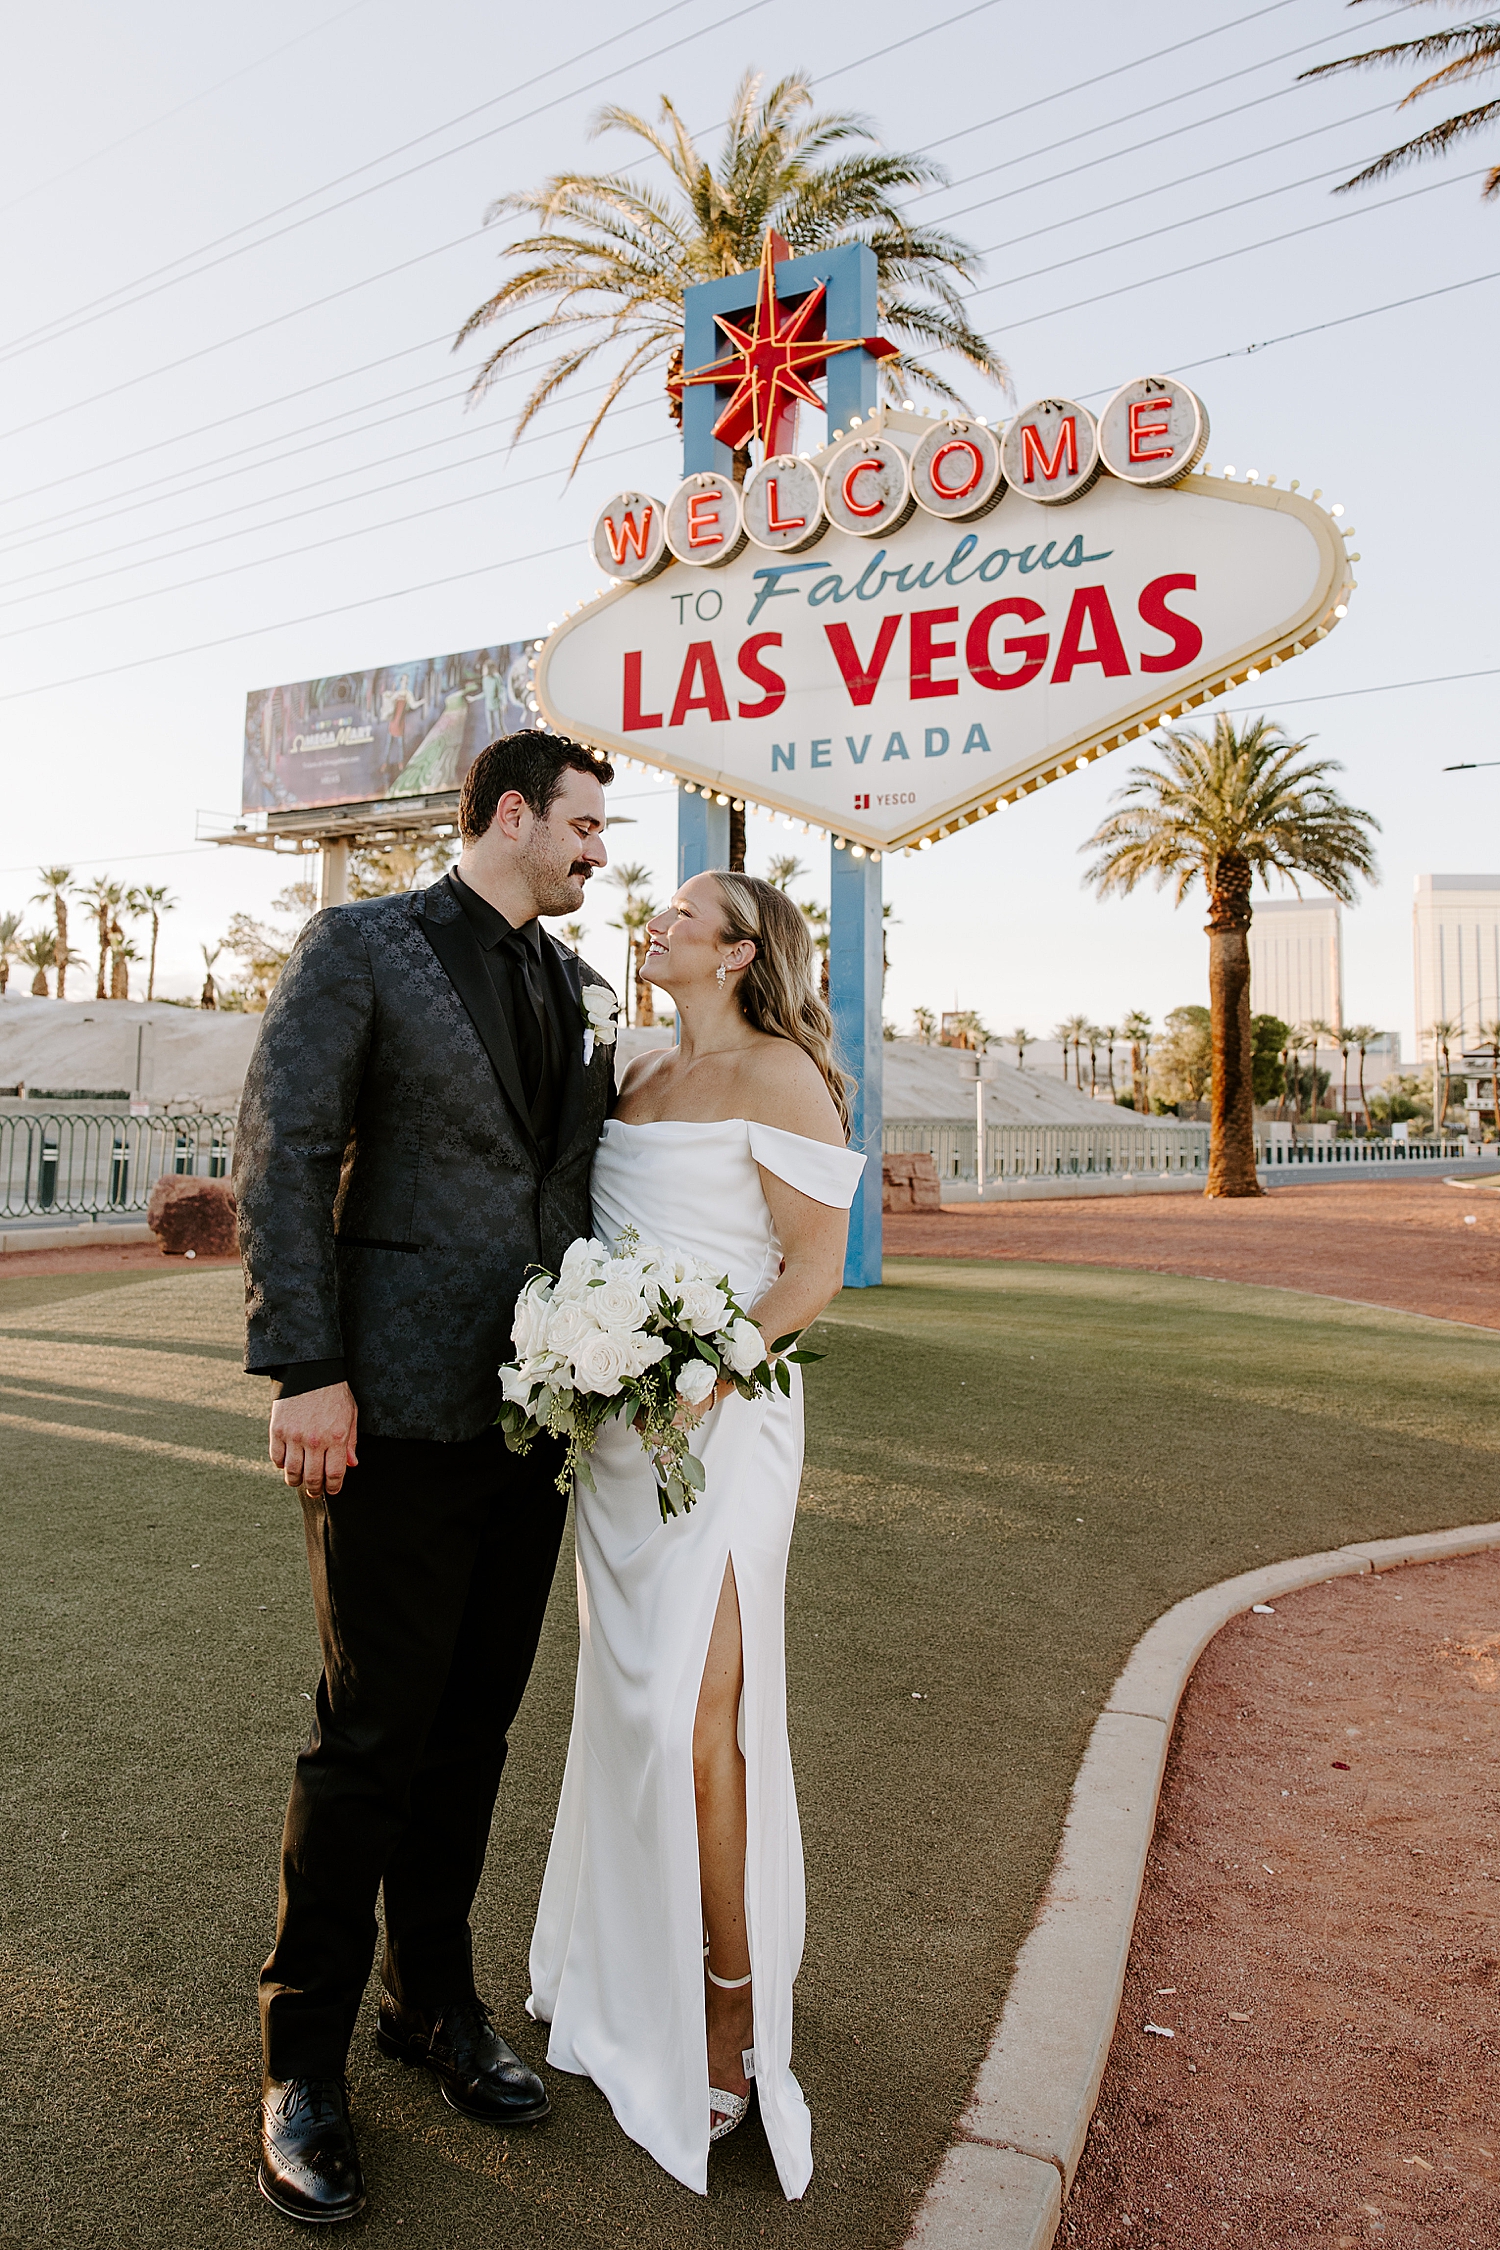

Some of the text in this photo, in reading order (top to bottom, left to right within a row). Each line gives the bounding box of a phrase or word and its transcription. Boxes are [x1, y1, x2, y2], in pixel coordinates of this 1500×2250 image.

[603, 397, 1174, 566] WELCOME
[670, 533, 1114, 627] TO Fabulous
[622, 573, 1203, 732] LAS VEGAS
[771, 722, 992, 773] NEVADA
[876, 791, 917, 806] YESCO
